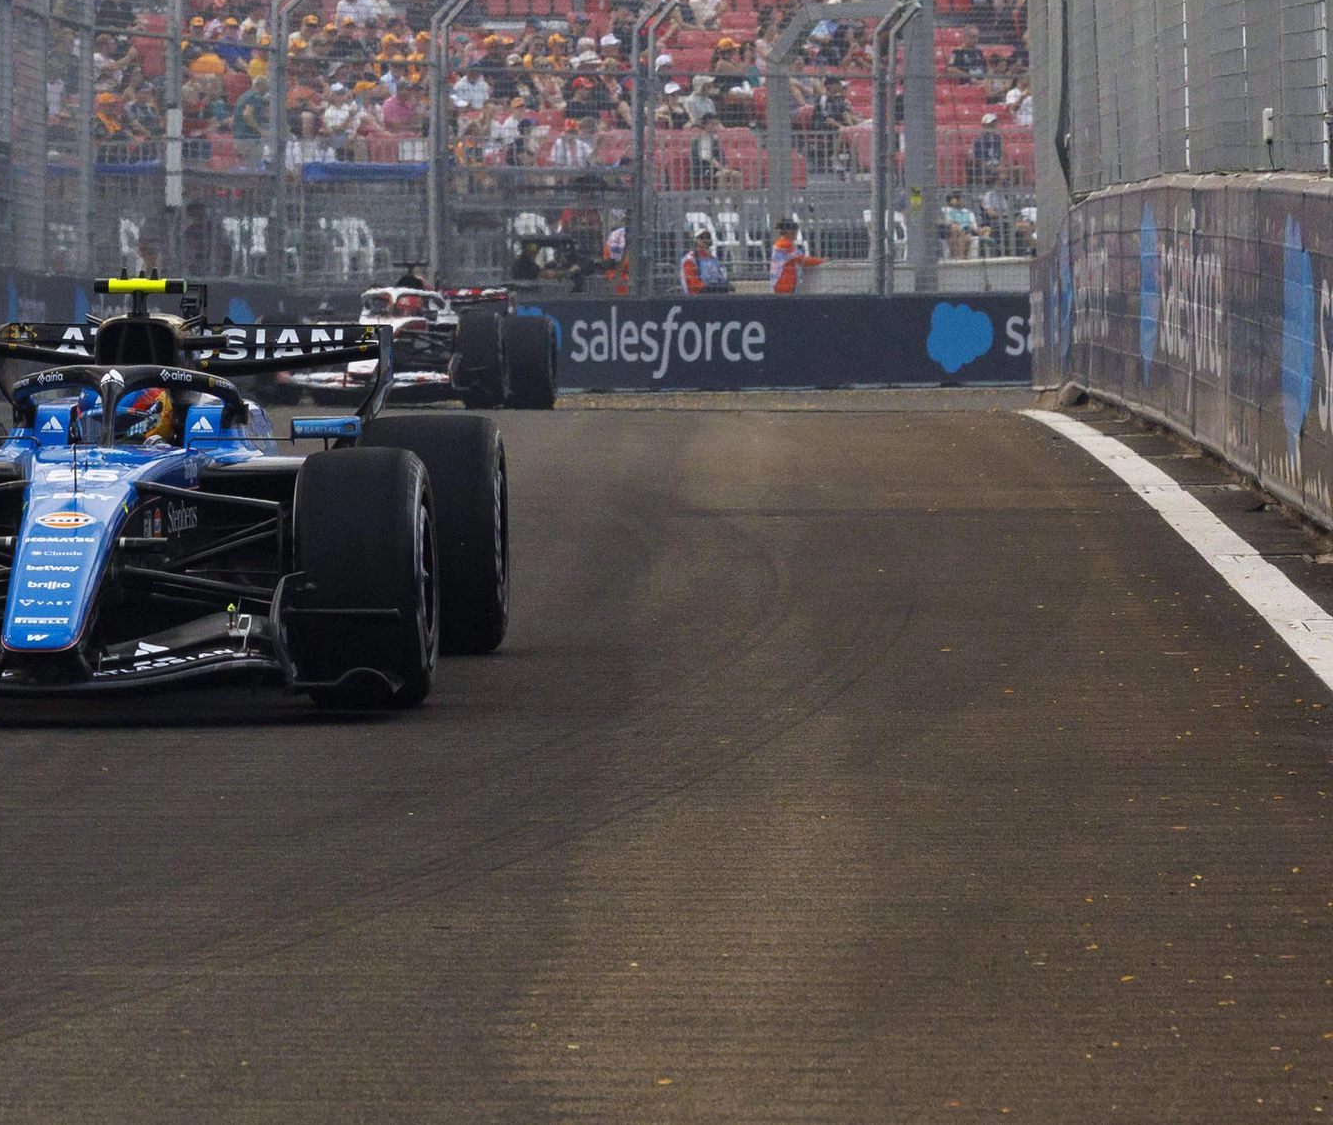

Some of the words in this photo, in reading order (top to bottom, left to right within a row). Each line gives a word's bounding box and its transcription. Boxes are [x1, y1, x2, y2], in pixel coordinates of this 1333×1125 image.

[56, 327, 344, 360] ASIAN
[570, 305, 766, 379] salesforce
[45, 371, 63, 382] airia
[171, 371, 192, 382] airia
[25, 564, 80, 572] betway
[27, 580, 71, 590] brillio
